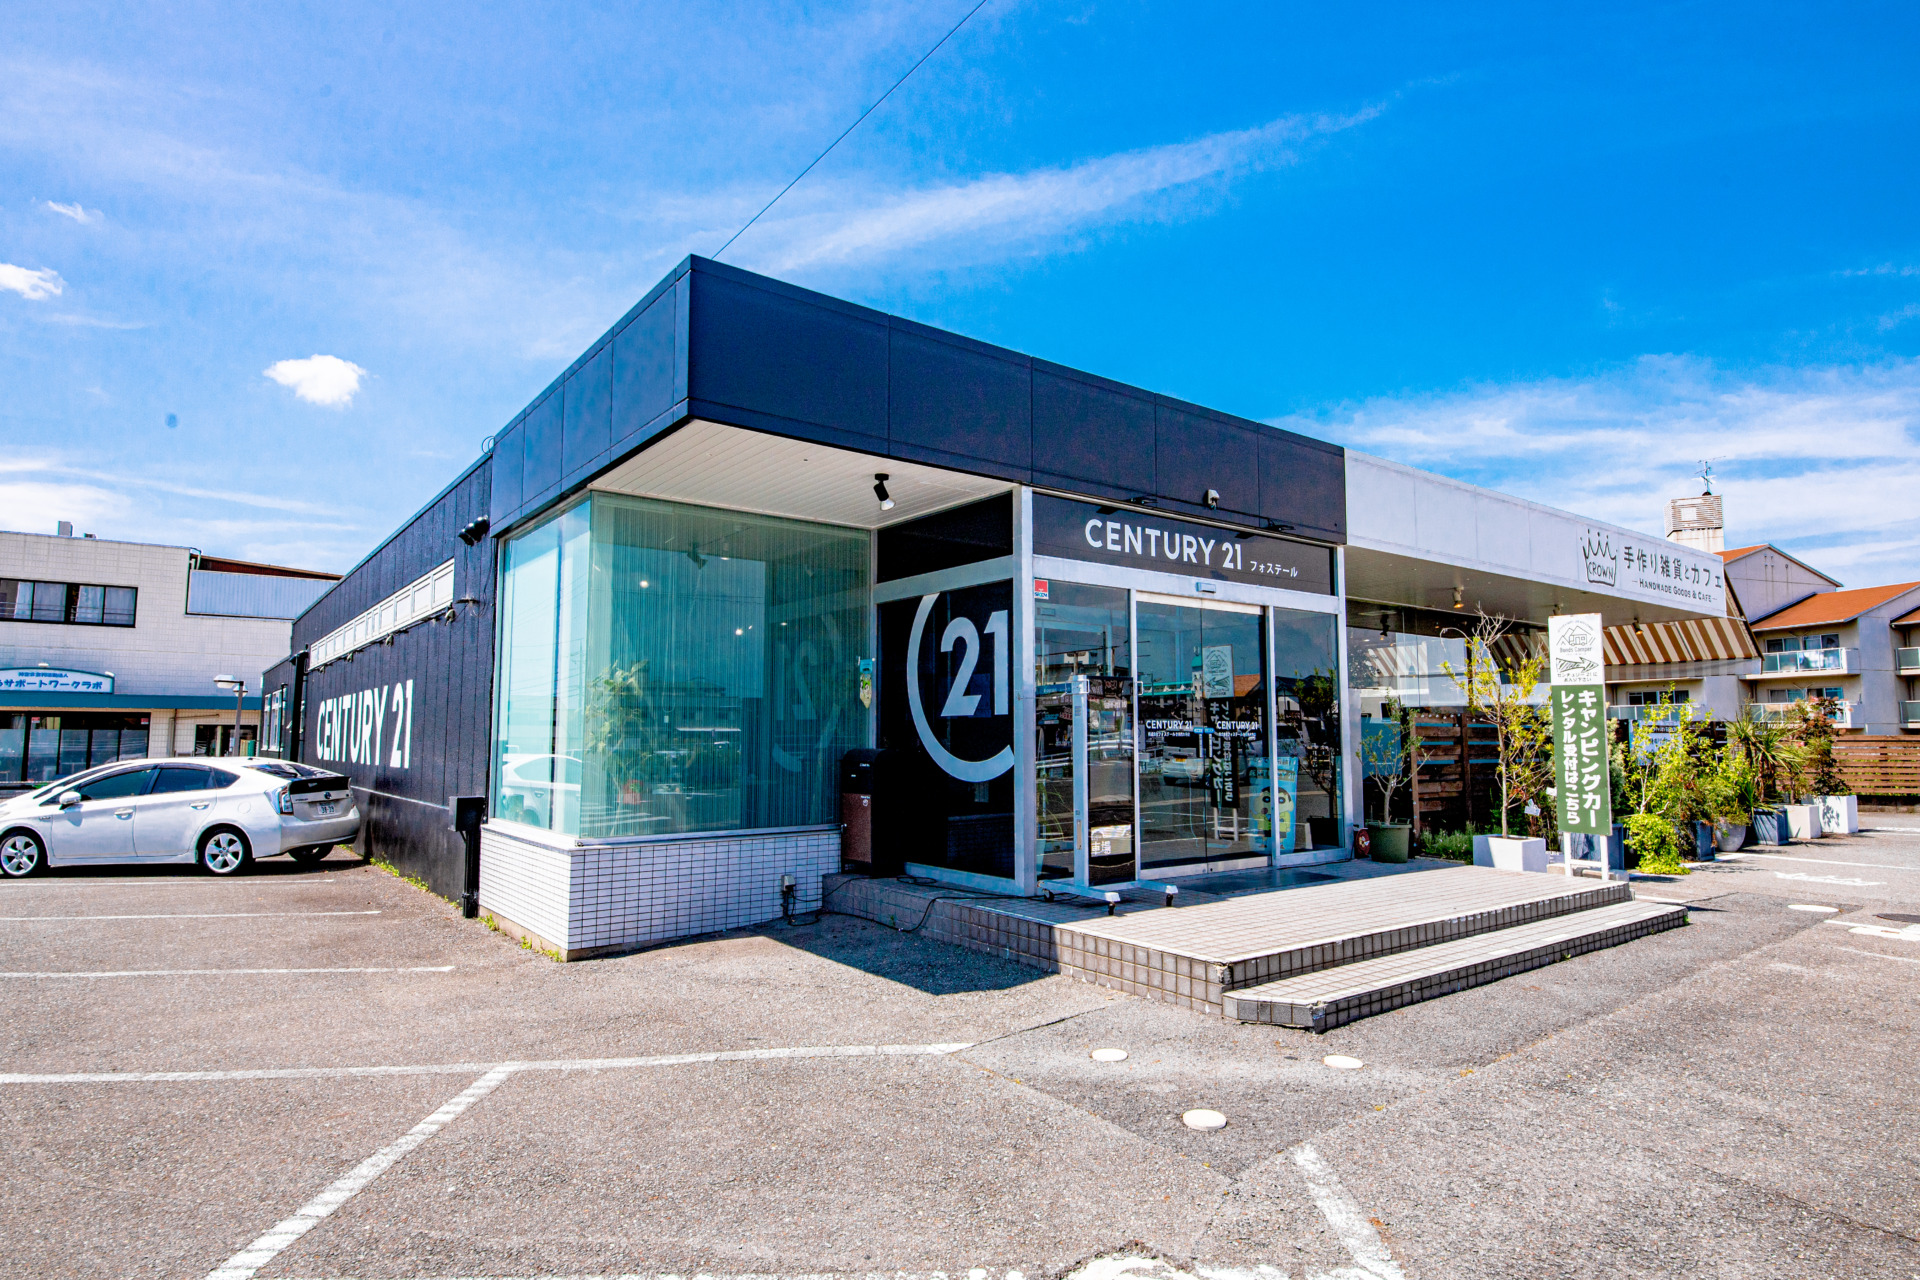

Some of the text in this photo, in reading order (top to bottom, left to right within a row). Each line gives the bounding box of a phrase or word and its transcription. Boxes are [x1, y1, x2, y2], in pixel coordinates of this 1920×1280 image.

[1085, 518, 1243, 570] CENTURY 21
[1250, 560, 1298, 578] フォステール
[1587, 561, 1614, 580] CROWN
[1623, 545, 1722, 589] 手作り雑貨とカフェ
[316, 679, 413, 769] CENTURY 21
[1146, 720, 1183, 730] CENTURY
[1184, 720, 1193, 730] 21
[1216, 721, 1250, 730] CENTURY
[1561, 690, 1580, 825] レンタル受付はこちら
[1578, 689, 1601, 828] キャンピングカー
